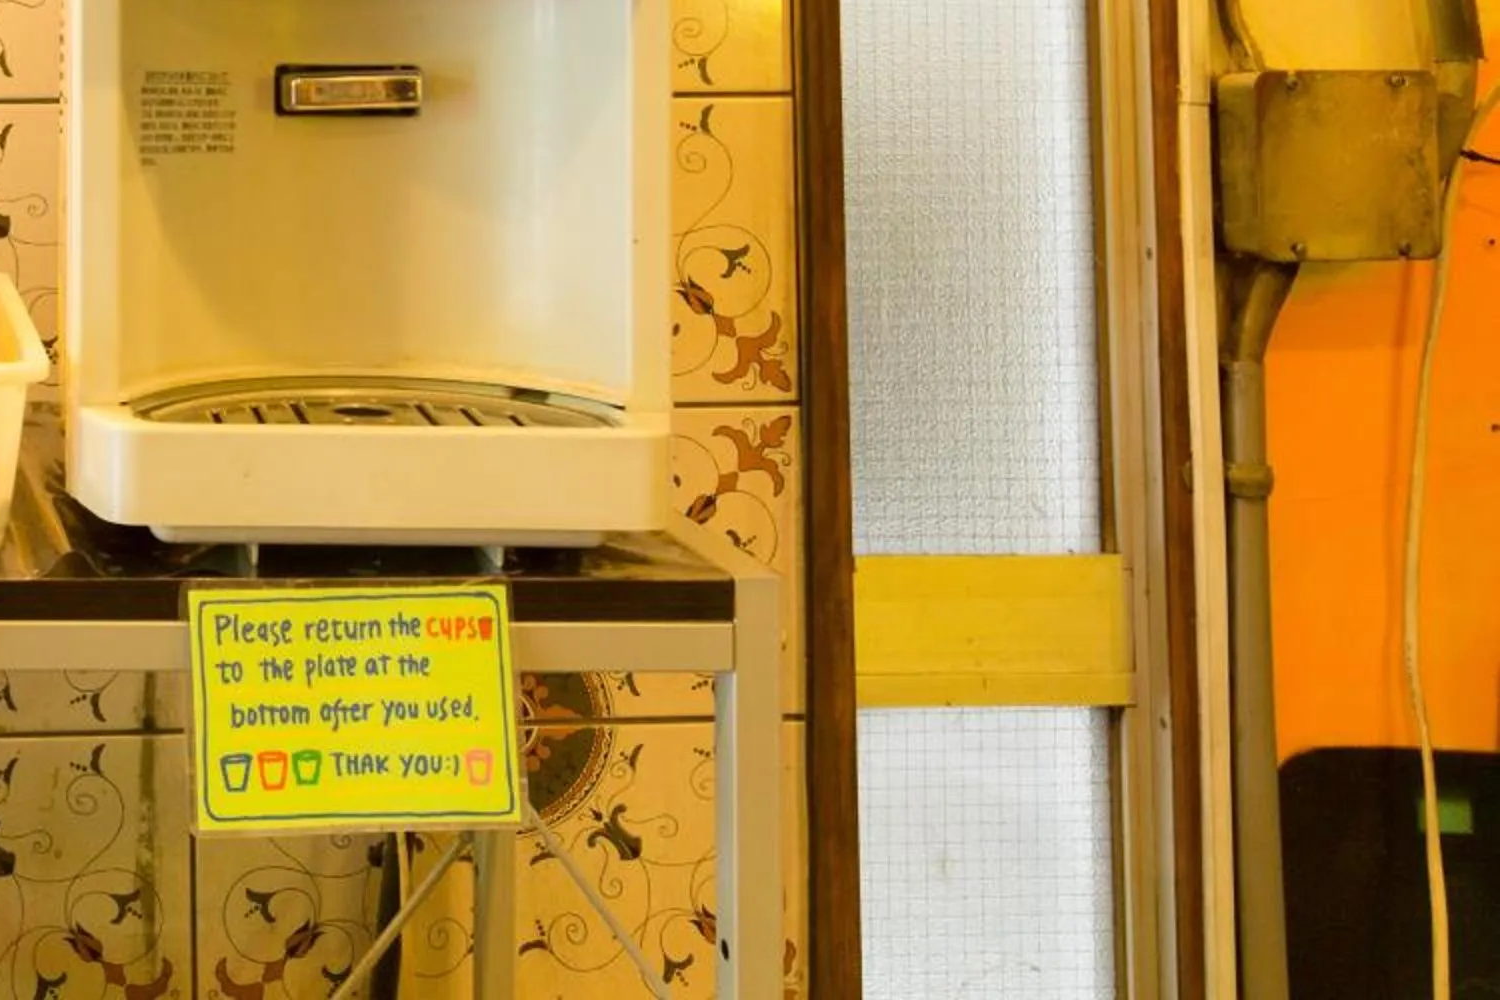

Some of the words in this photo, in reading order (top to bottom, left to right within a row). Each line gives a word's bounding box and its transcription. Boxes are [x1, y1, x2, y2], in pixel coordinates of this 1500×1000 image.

[214, 614, 293, 647] Please
[304, 618, 383, 642] return
[388, 612, 421, 639] the
[426, 616, 478, 641] cups
[216, 661, 244, 684] to
[259, 655, 294, 682] the
[305, 654, 357, 687] plate
[365, 655, 392, 676] at
[398, 653, 430, 676] the
[231, 702, 311, 728] bottom
[320, 698, 373, 732] after
[381, 698, 419, 725] you
[426, 695, 480, 722] used.
